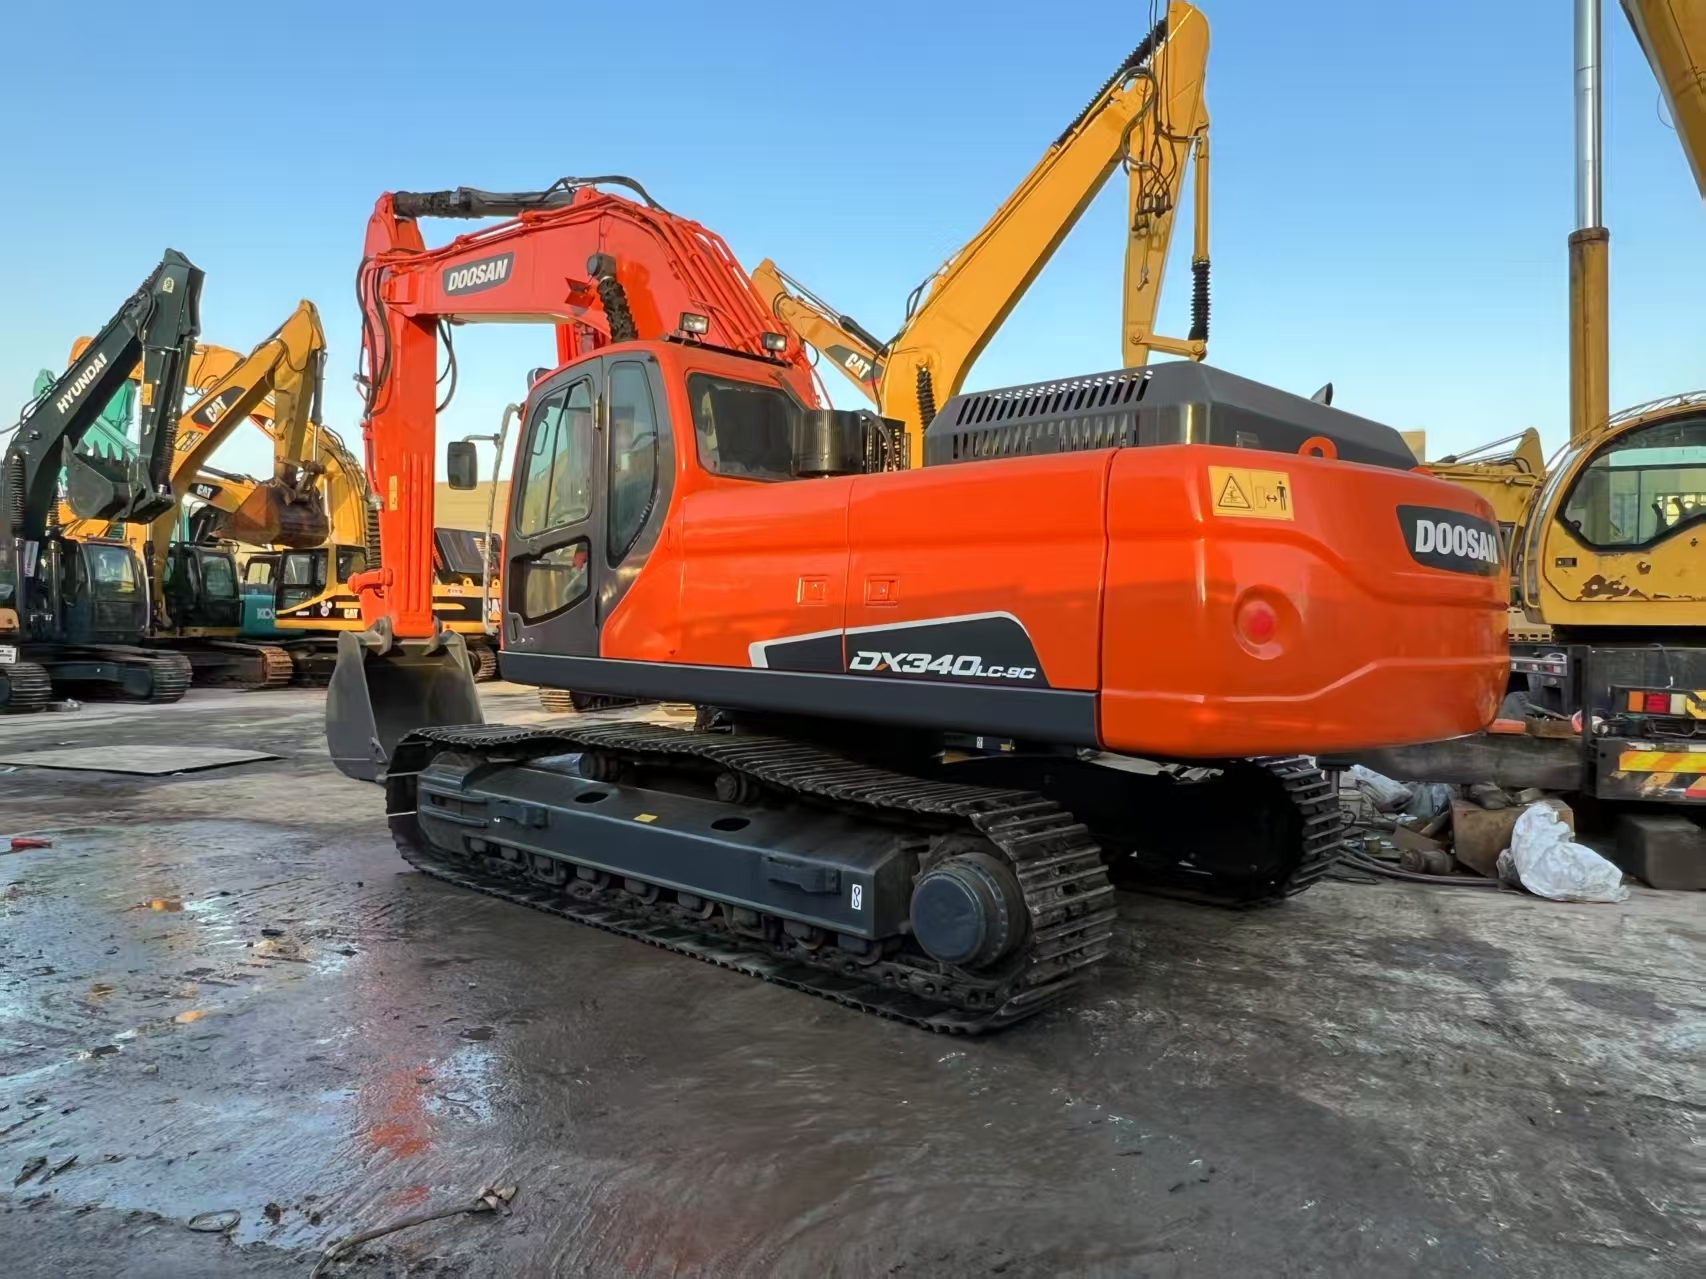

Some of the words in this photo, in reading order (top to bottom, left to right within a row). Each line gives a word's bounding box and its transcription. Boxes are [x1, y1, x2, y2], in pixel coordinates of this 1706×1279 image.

[448, 259, 508, 291] DOOSAN
[844, 353, 871, 378] CAT
[56, 353, 108, 413] HYUNDAI
[205, 395, 227, 423] CAT
[197, 484, 213, 499] CAT
[1415, 519, 1498, 564] DOOSAN
[344, 608, 358, 619] CAT
